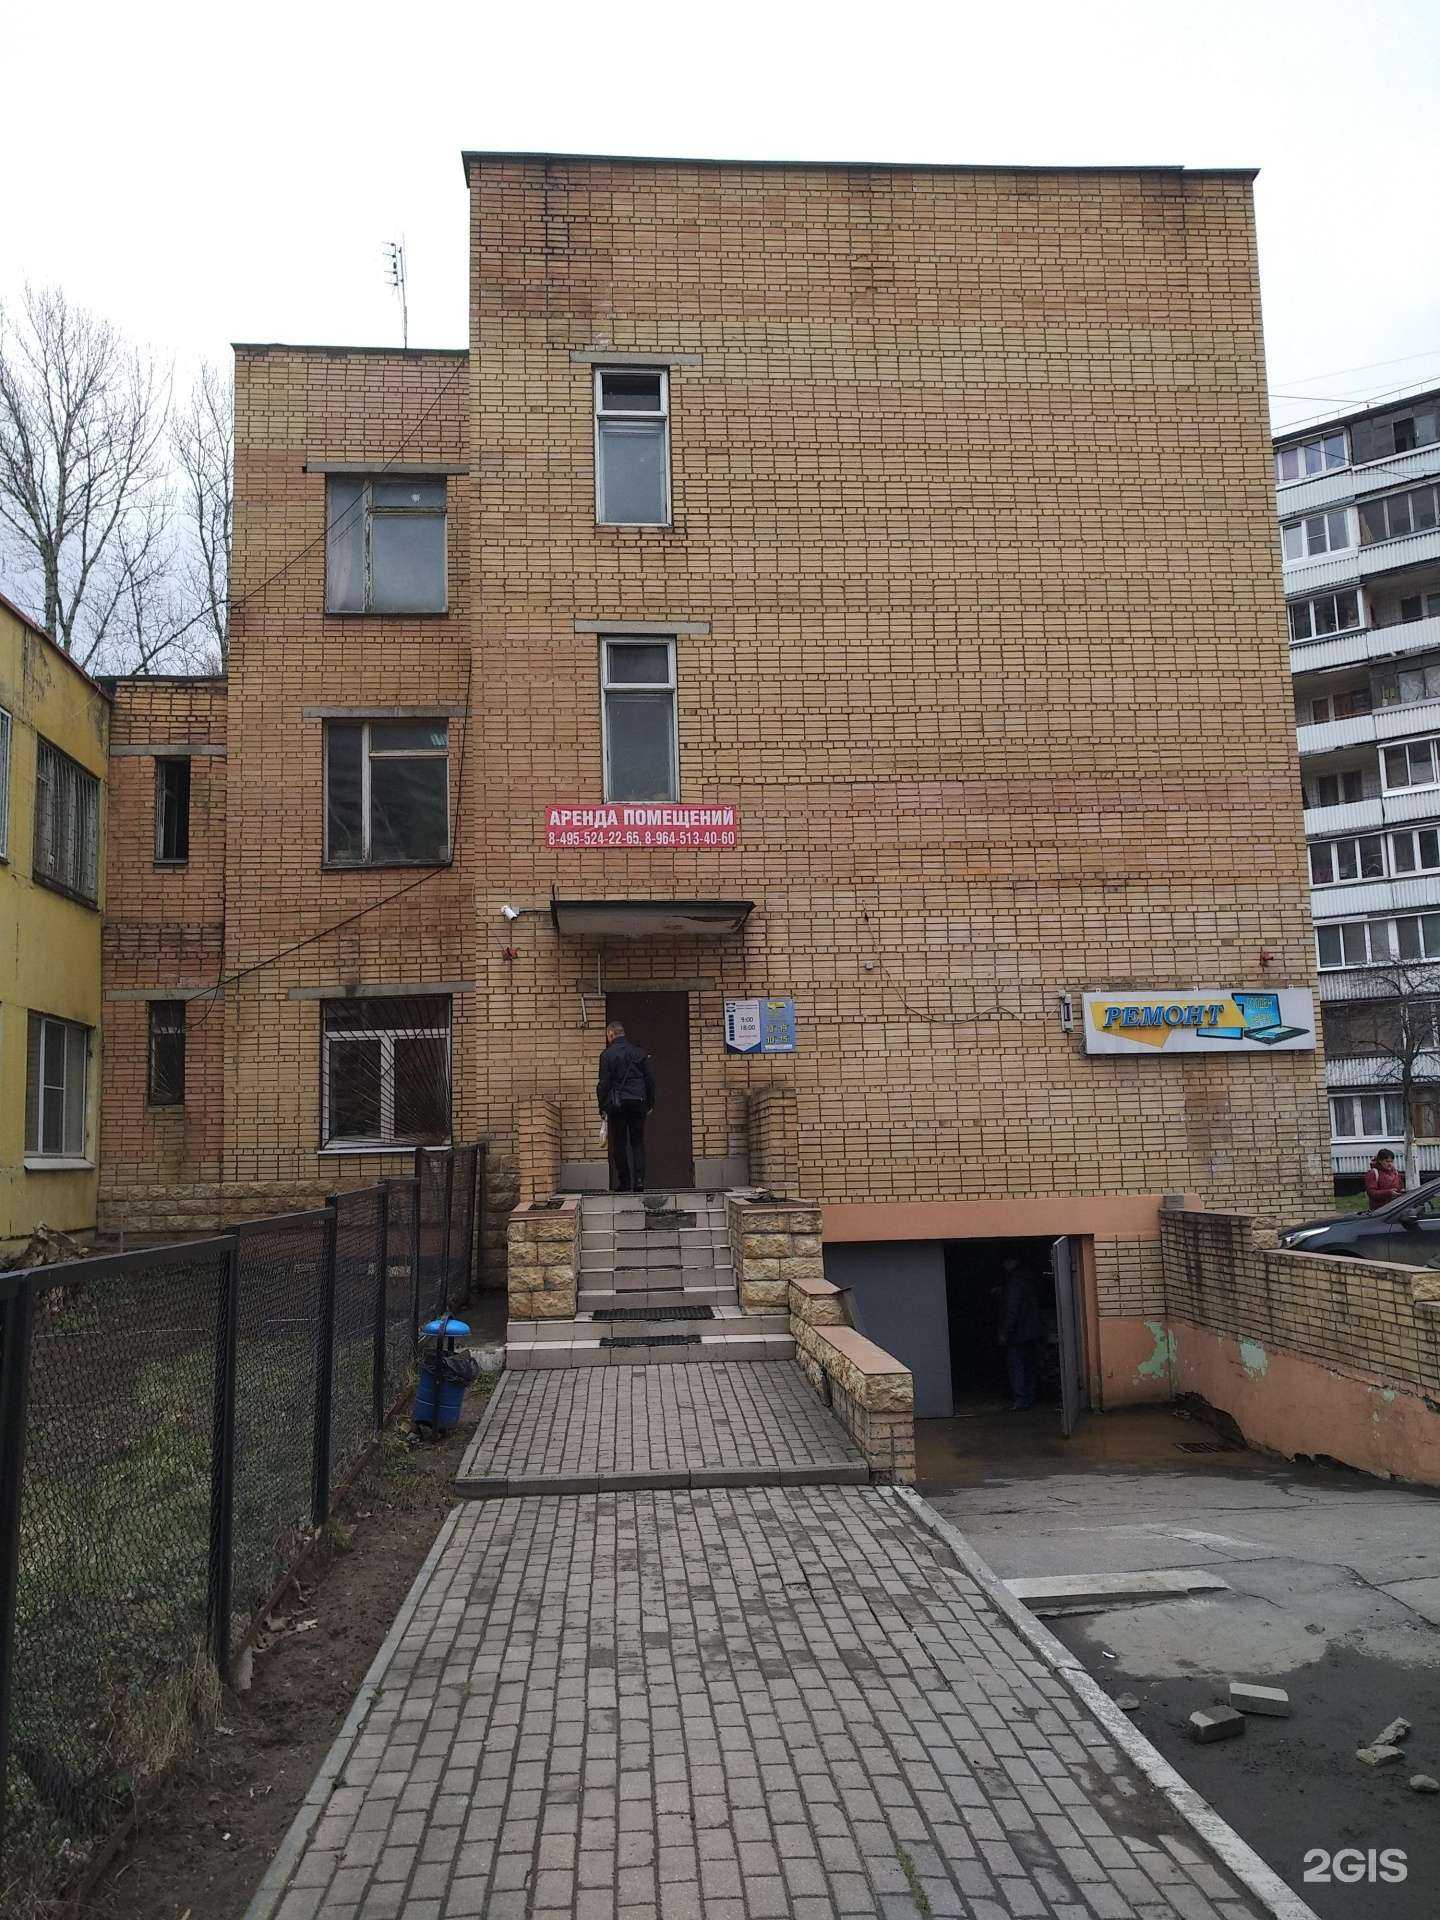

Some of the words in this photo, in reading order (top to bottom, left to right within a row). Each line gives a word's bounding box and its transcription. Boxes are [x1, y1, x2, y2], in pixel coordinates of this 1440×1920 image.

[549, 809, 618, 828] АРЕНДА
[623, 806, 734, 828] ПОМЕЩЕНИЙ
[548, 831, 642, 846] 8-495-524-22-65,
[645, 831, 735, 845] 8-964-513-40-60
[1102, 1004, 1225, 1028] РЕМОНТ
